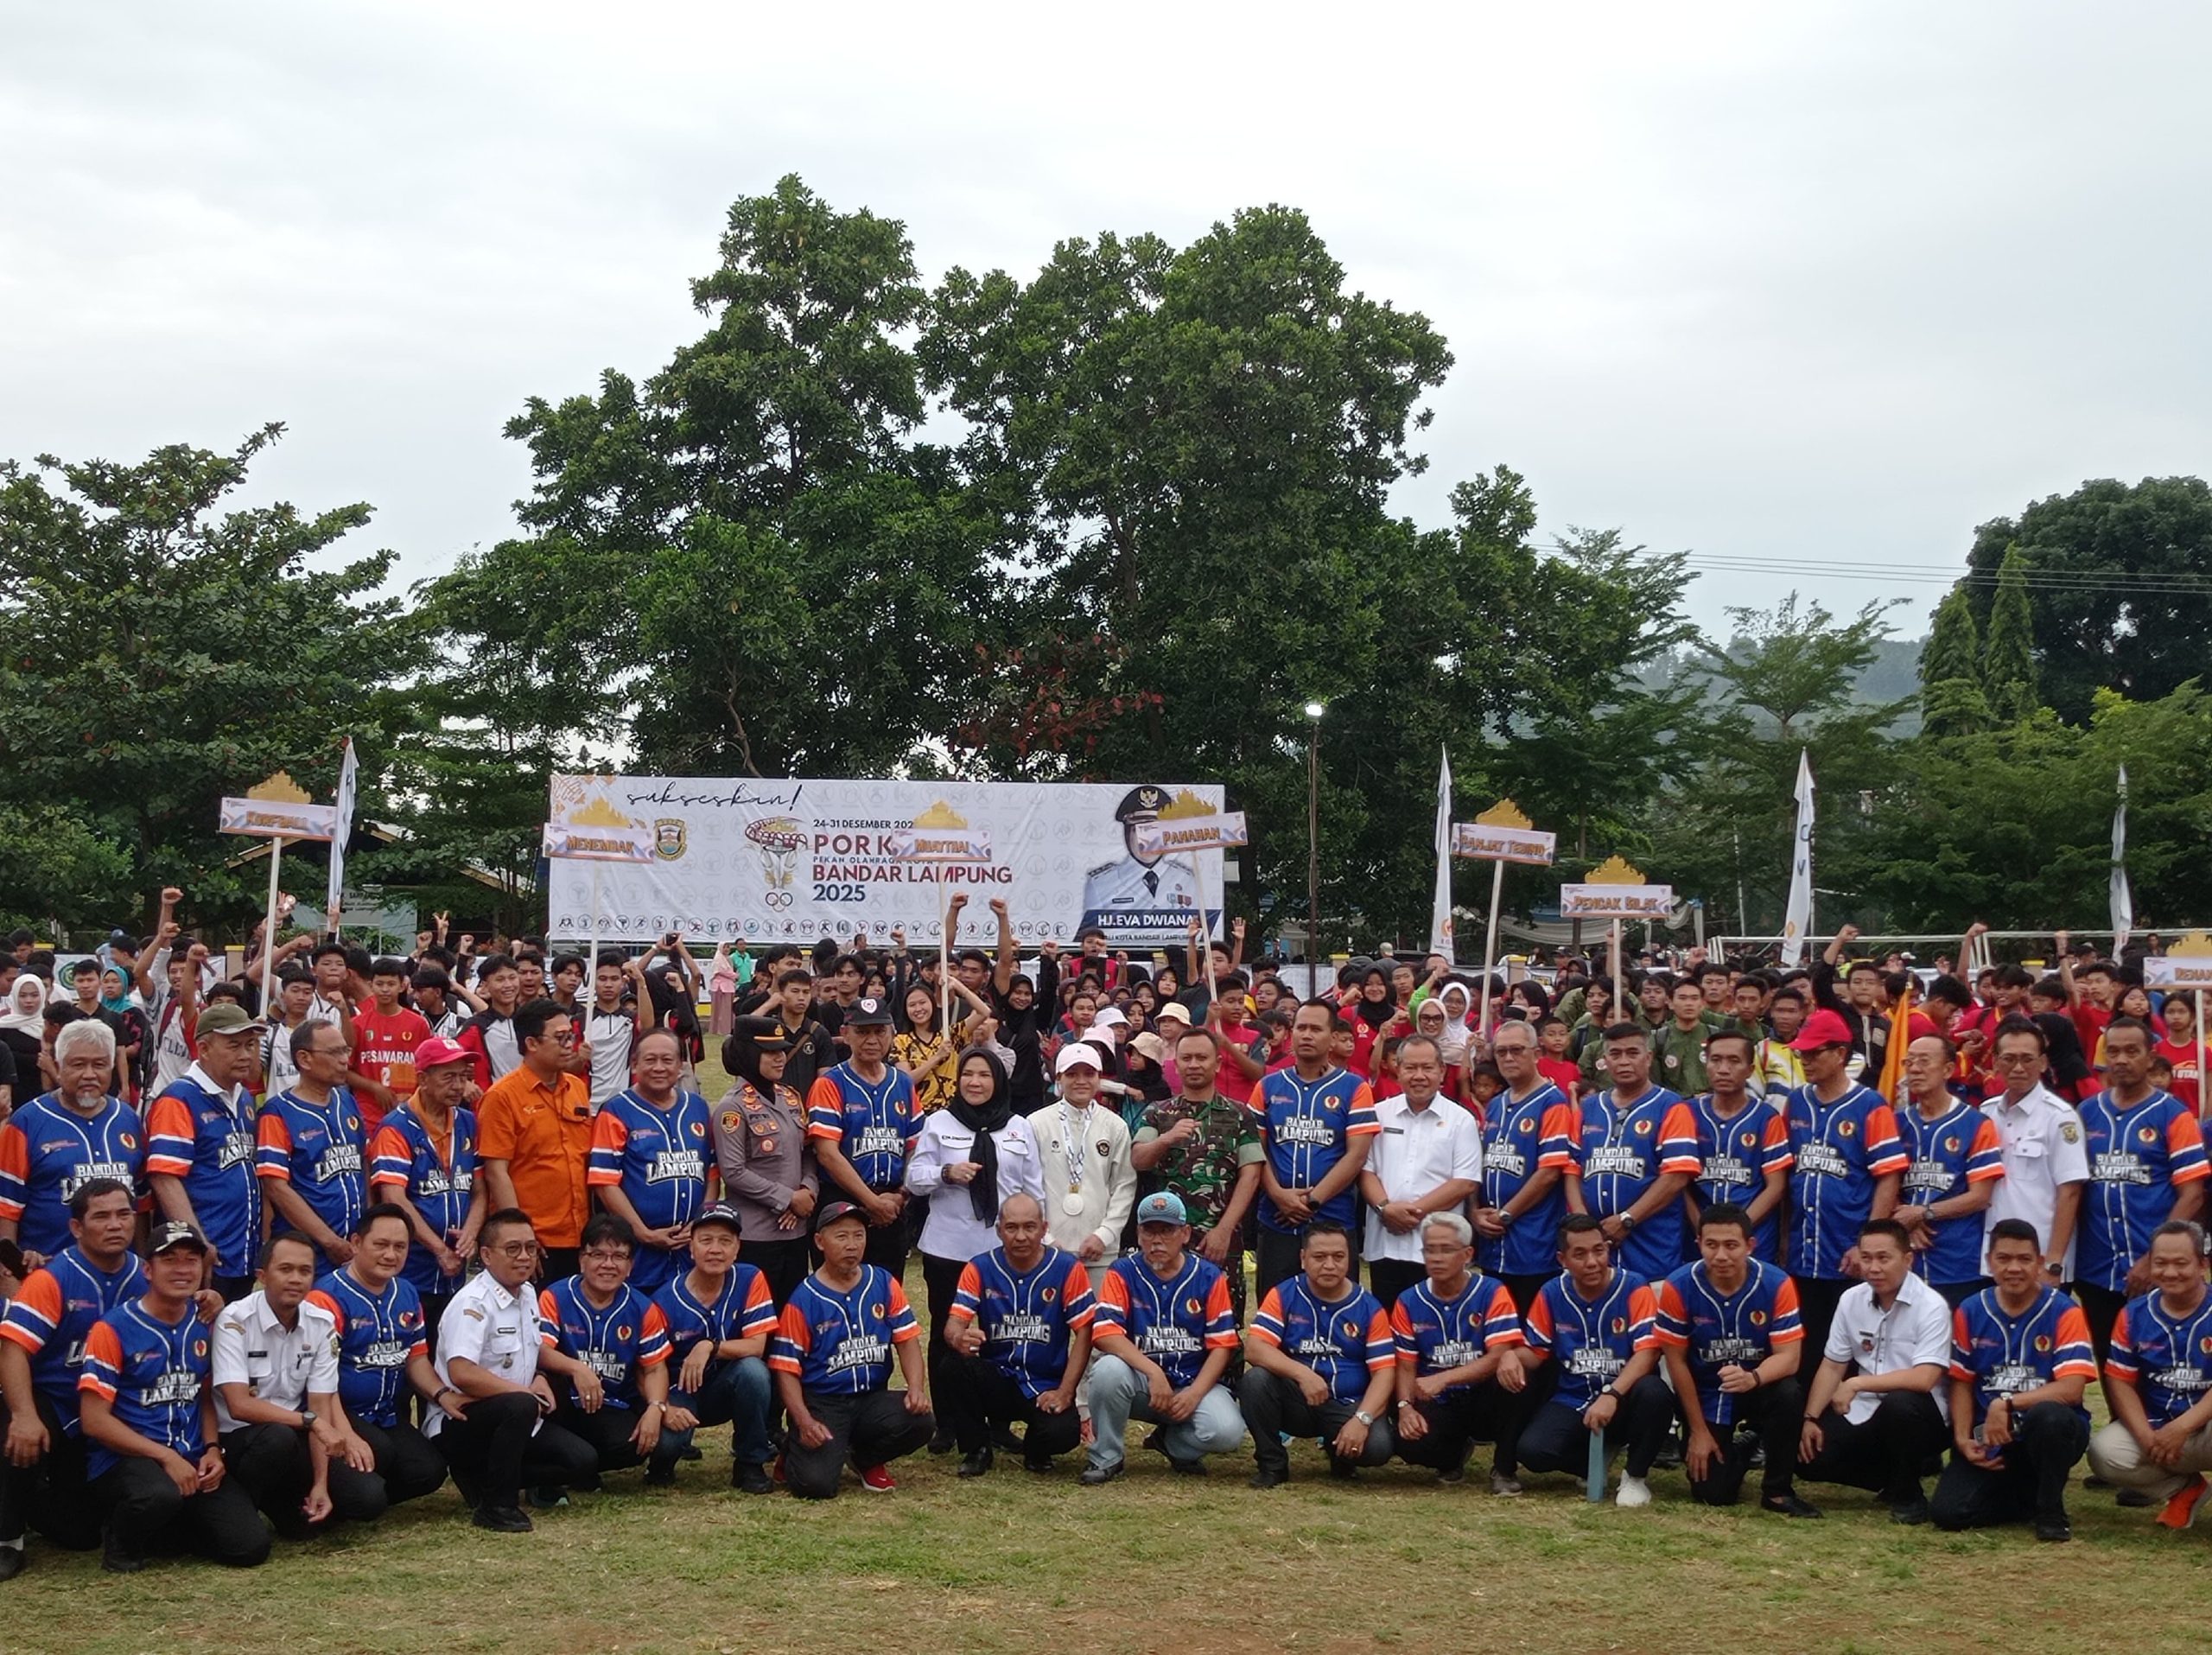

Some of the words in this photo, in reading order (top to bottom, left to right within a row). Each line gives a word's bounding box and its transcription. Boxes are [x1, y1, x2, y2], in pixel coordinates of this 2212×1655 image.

[626, 781, 803, 812] sukseskan!
[813, 818, 840, 828] 24-31
[842, 819, 891, 830] DESEMBER
[894, 820, 914, 830] 202
[813, 865, 902, 882] BANDAR
[812, 884, 866, 902] 2025
[1274, 1125, 1334, 1146] LAMPUNG
[852, 1137, 905, 1158] LAMPUNG
[74, 1162, 128, 1176] BANDAR
[1003, 1315, 1042, 1327] BANDAR
[990, 1324, 1051, 1343] LAMPUNG
